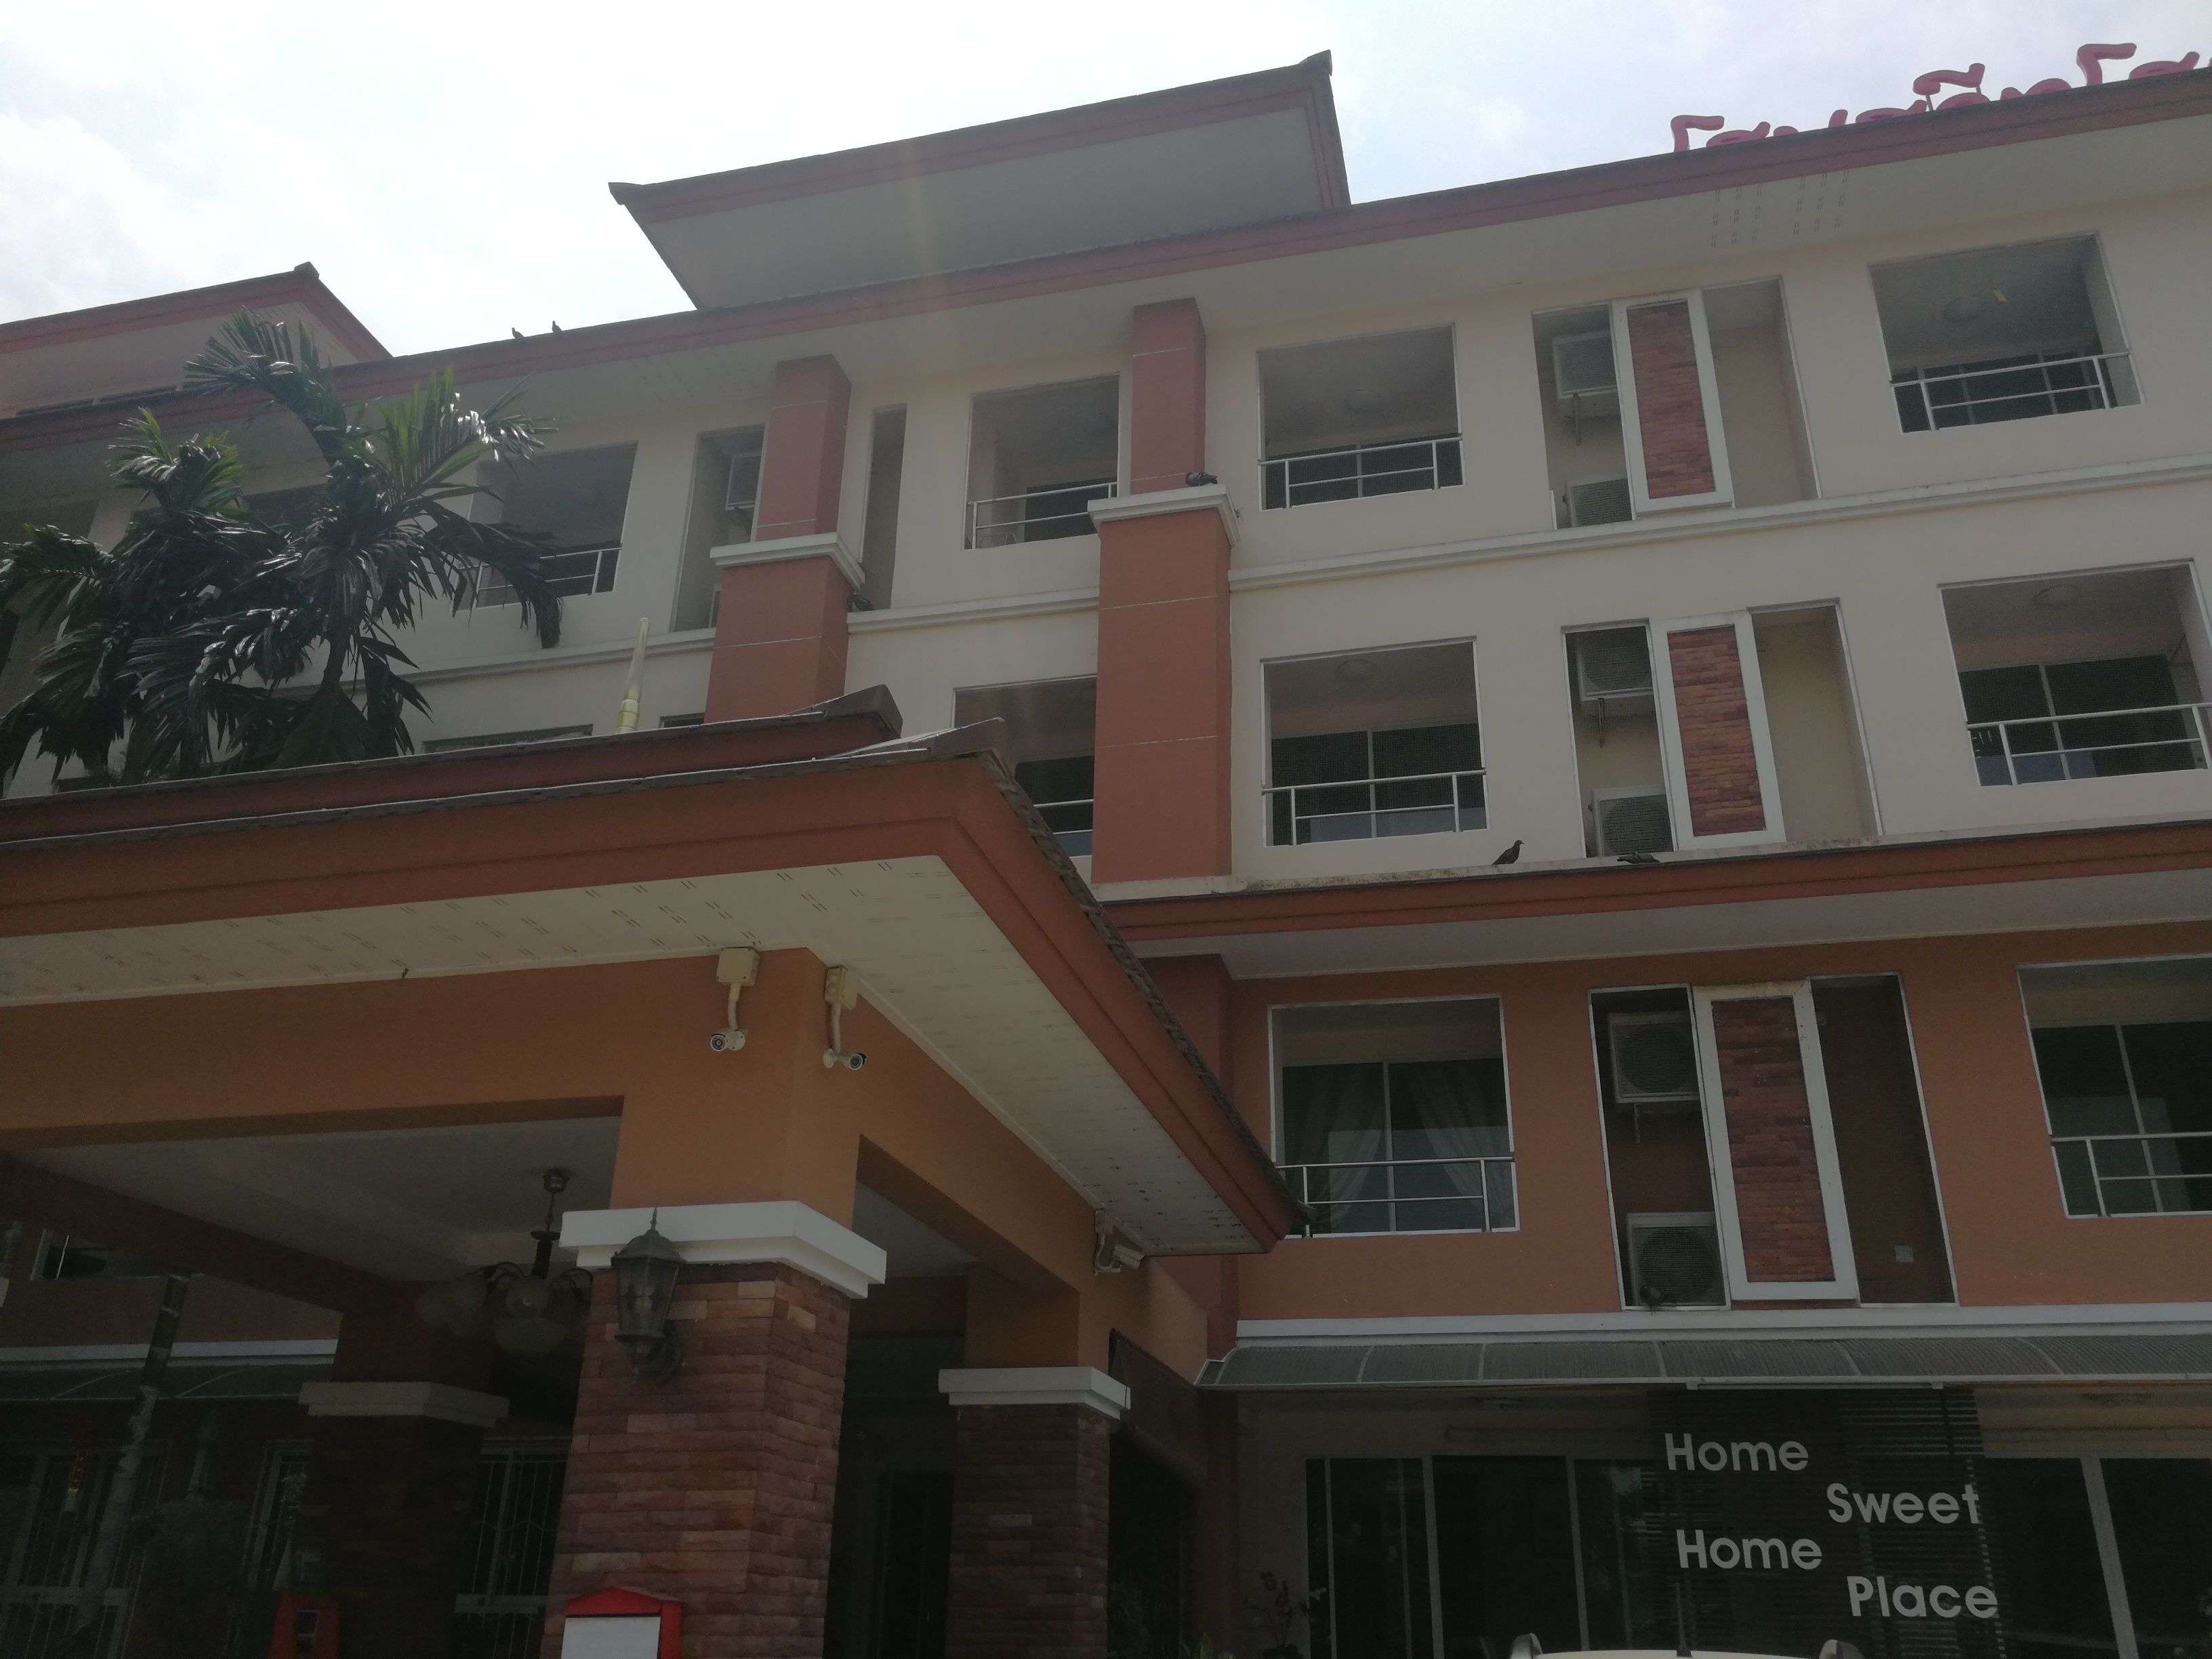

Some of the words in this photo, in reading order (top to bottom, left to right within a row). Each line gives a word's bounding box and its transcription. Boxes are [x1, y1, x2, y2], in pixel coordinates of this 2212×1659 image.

[1665, 1433, 1809, 1471] Home
[1826, 1483, 1981, 1523] Sweet
[1676, 1530, 1822, 1570] Home
[1847, 1576, 1999, 1618] Place
